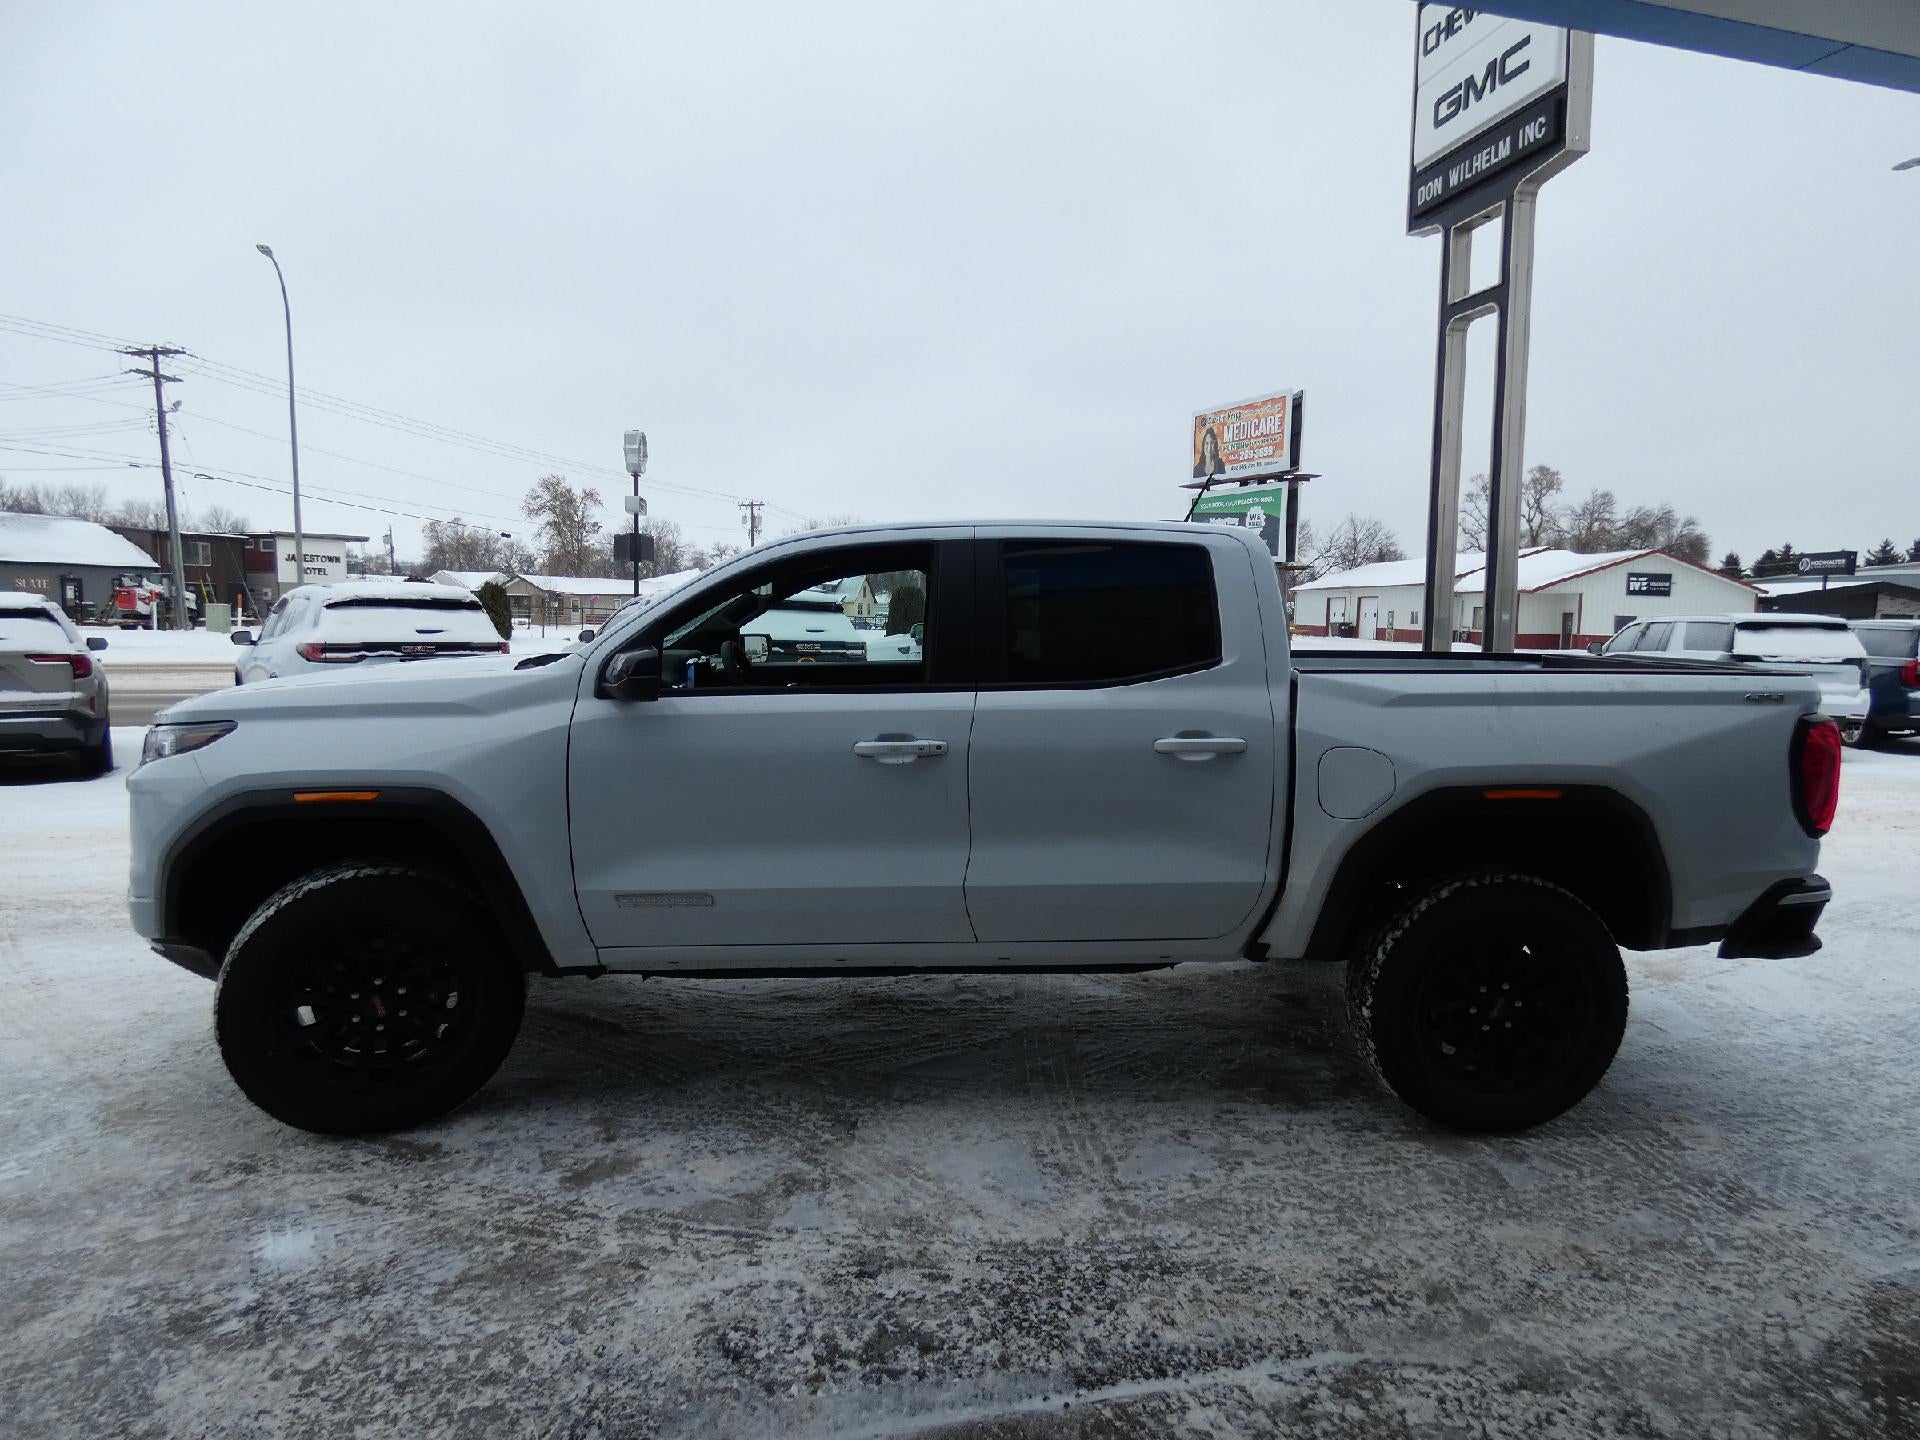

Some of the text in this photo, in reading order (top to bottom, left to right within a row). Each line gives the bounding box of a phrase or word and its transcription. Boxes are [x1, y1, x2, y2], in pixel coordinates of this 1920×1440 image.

[1433, 34, 1531, 129] GMC
[1417, 116, 1547, 206] DON WILHELM INC
[1223, 414, 1282, 442] MEDICARE
[1249, 513, 1260, 521] WE
[285, 554, 341, 564] JAESTOWN
